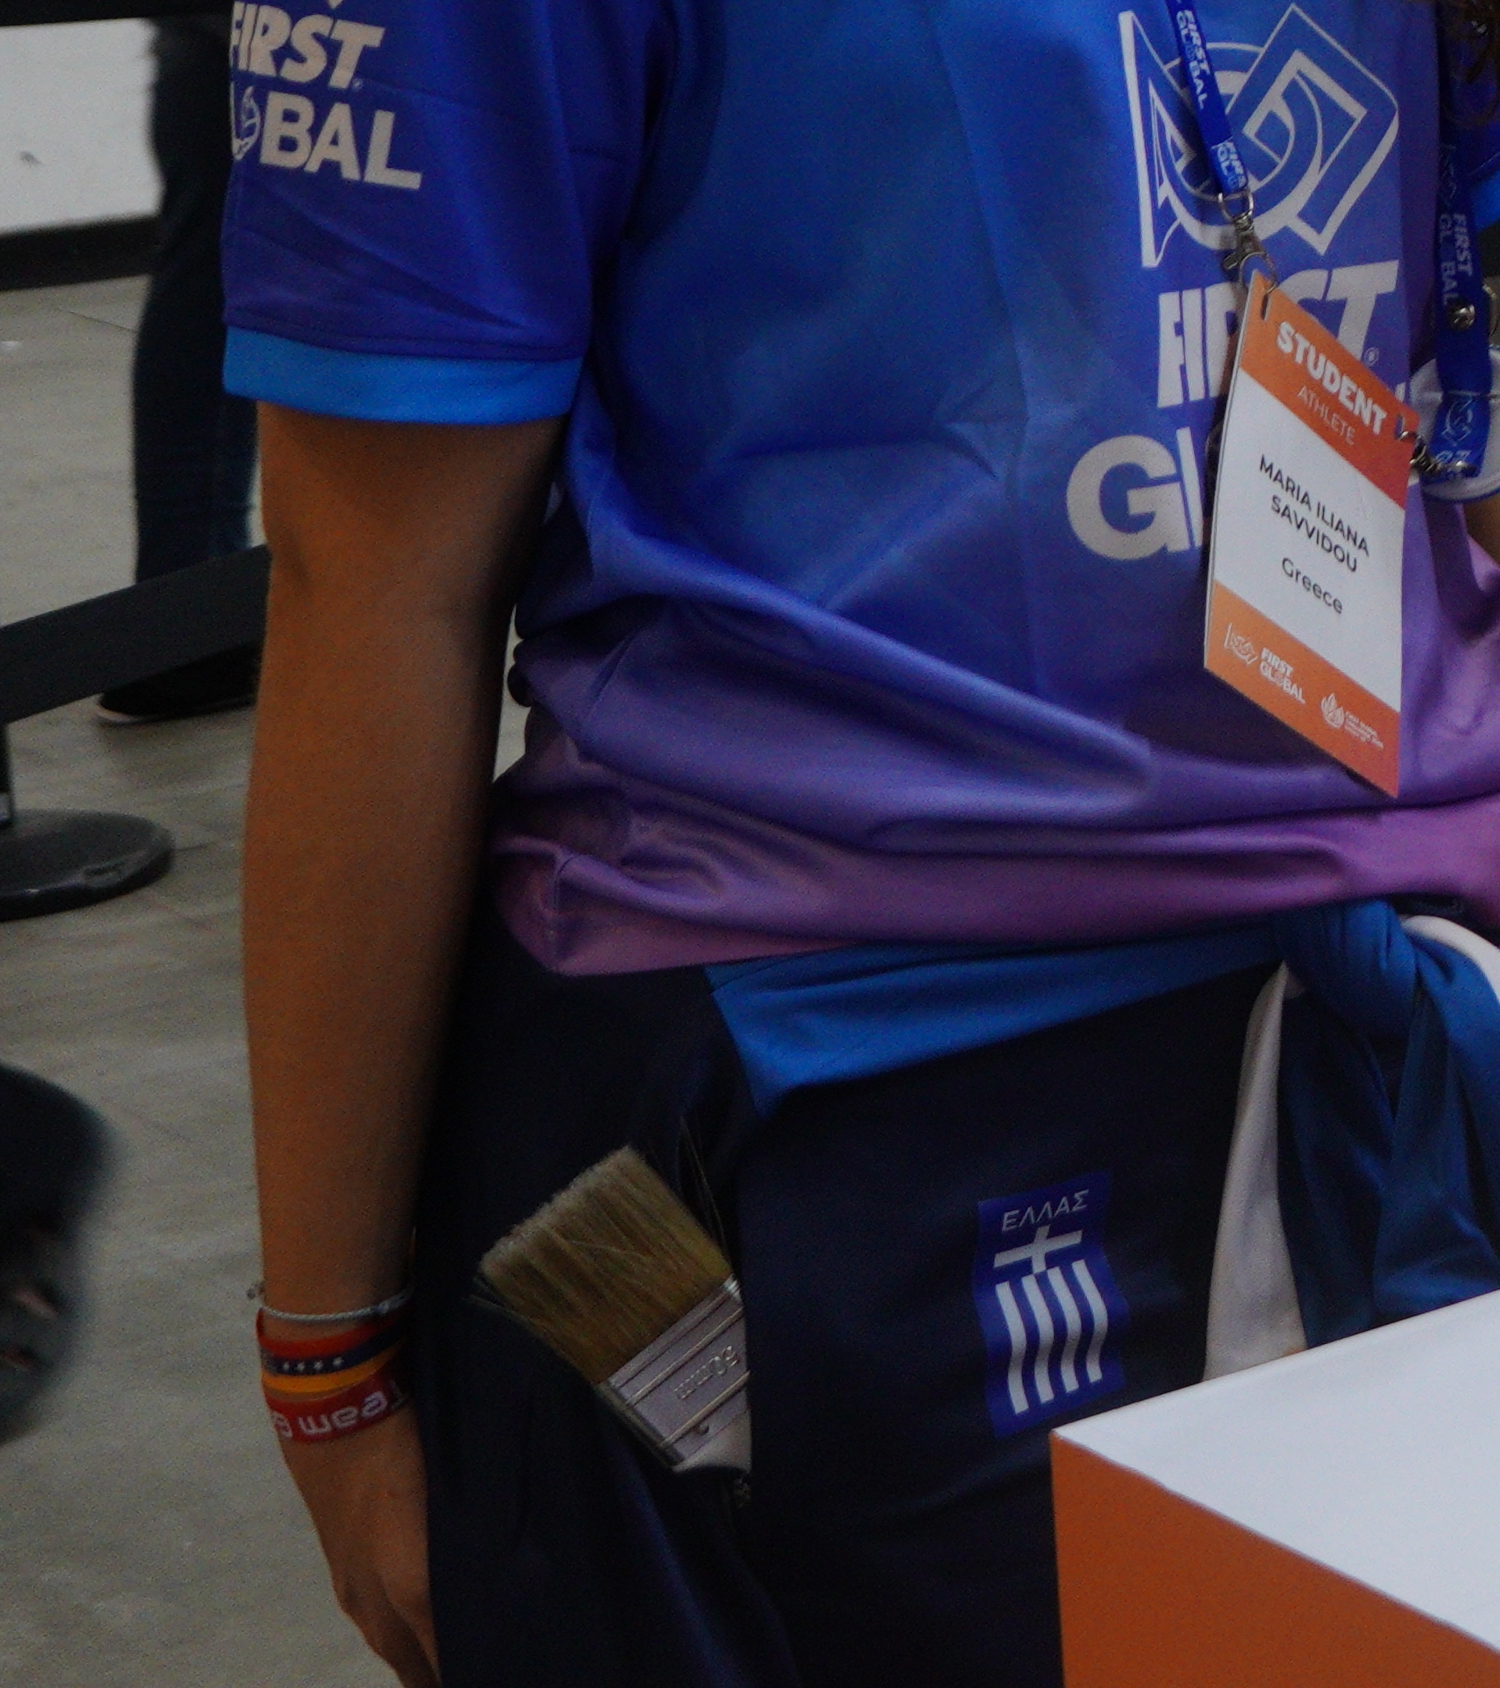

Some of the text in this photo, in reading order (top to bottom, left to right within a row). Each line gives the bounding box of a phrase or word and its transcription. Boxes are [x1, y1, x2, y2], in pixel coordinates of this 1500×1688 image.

[1438, 212, 1461, 305] GLBAL
[1276, 320, 1387, 436] STUDENT
[1297, 385, 1355, 446] ATHLETE
[1259, 453, 1312, 511] MARIA
[1316, 502, 1370, 557] ILIANA
[1271, 495, 1357, 573] SAVVIDOU
[1281, 557, 1343, 614] Greece
[1001, 1189, 1089, 1231] ΕΛΛΑΣ
